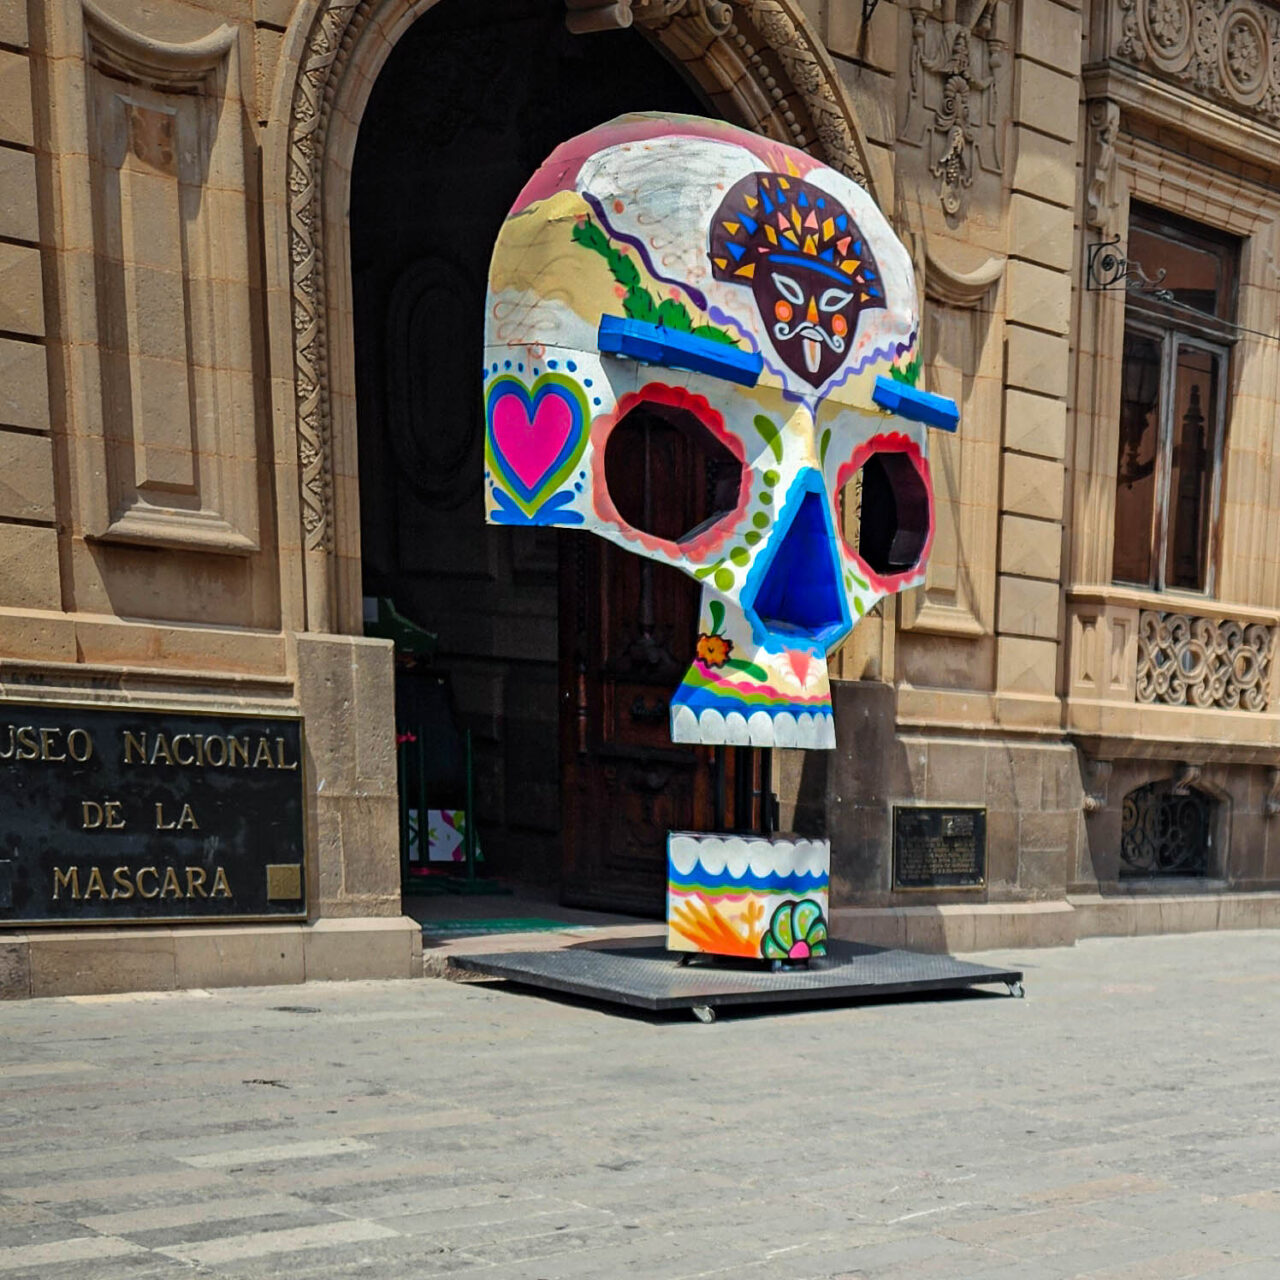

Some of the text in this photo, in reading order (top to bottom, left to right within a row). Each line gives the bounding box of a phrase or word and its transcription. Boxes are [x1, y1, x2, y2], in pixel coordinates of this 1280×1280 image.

[123, 731, 298, 770] NACIONAL
[82, 801, 200, 830] DE LA
[52, 866, 233, 900] MASCARA
